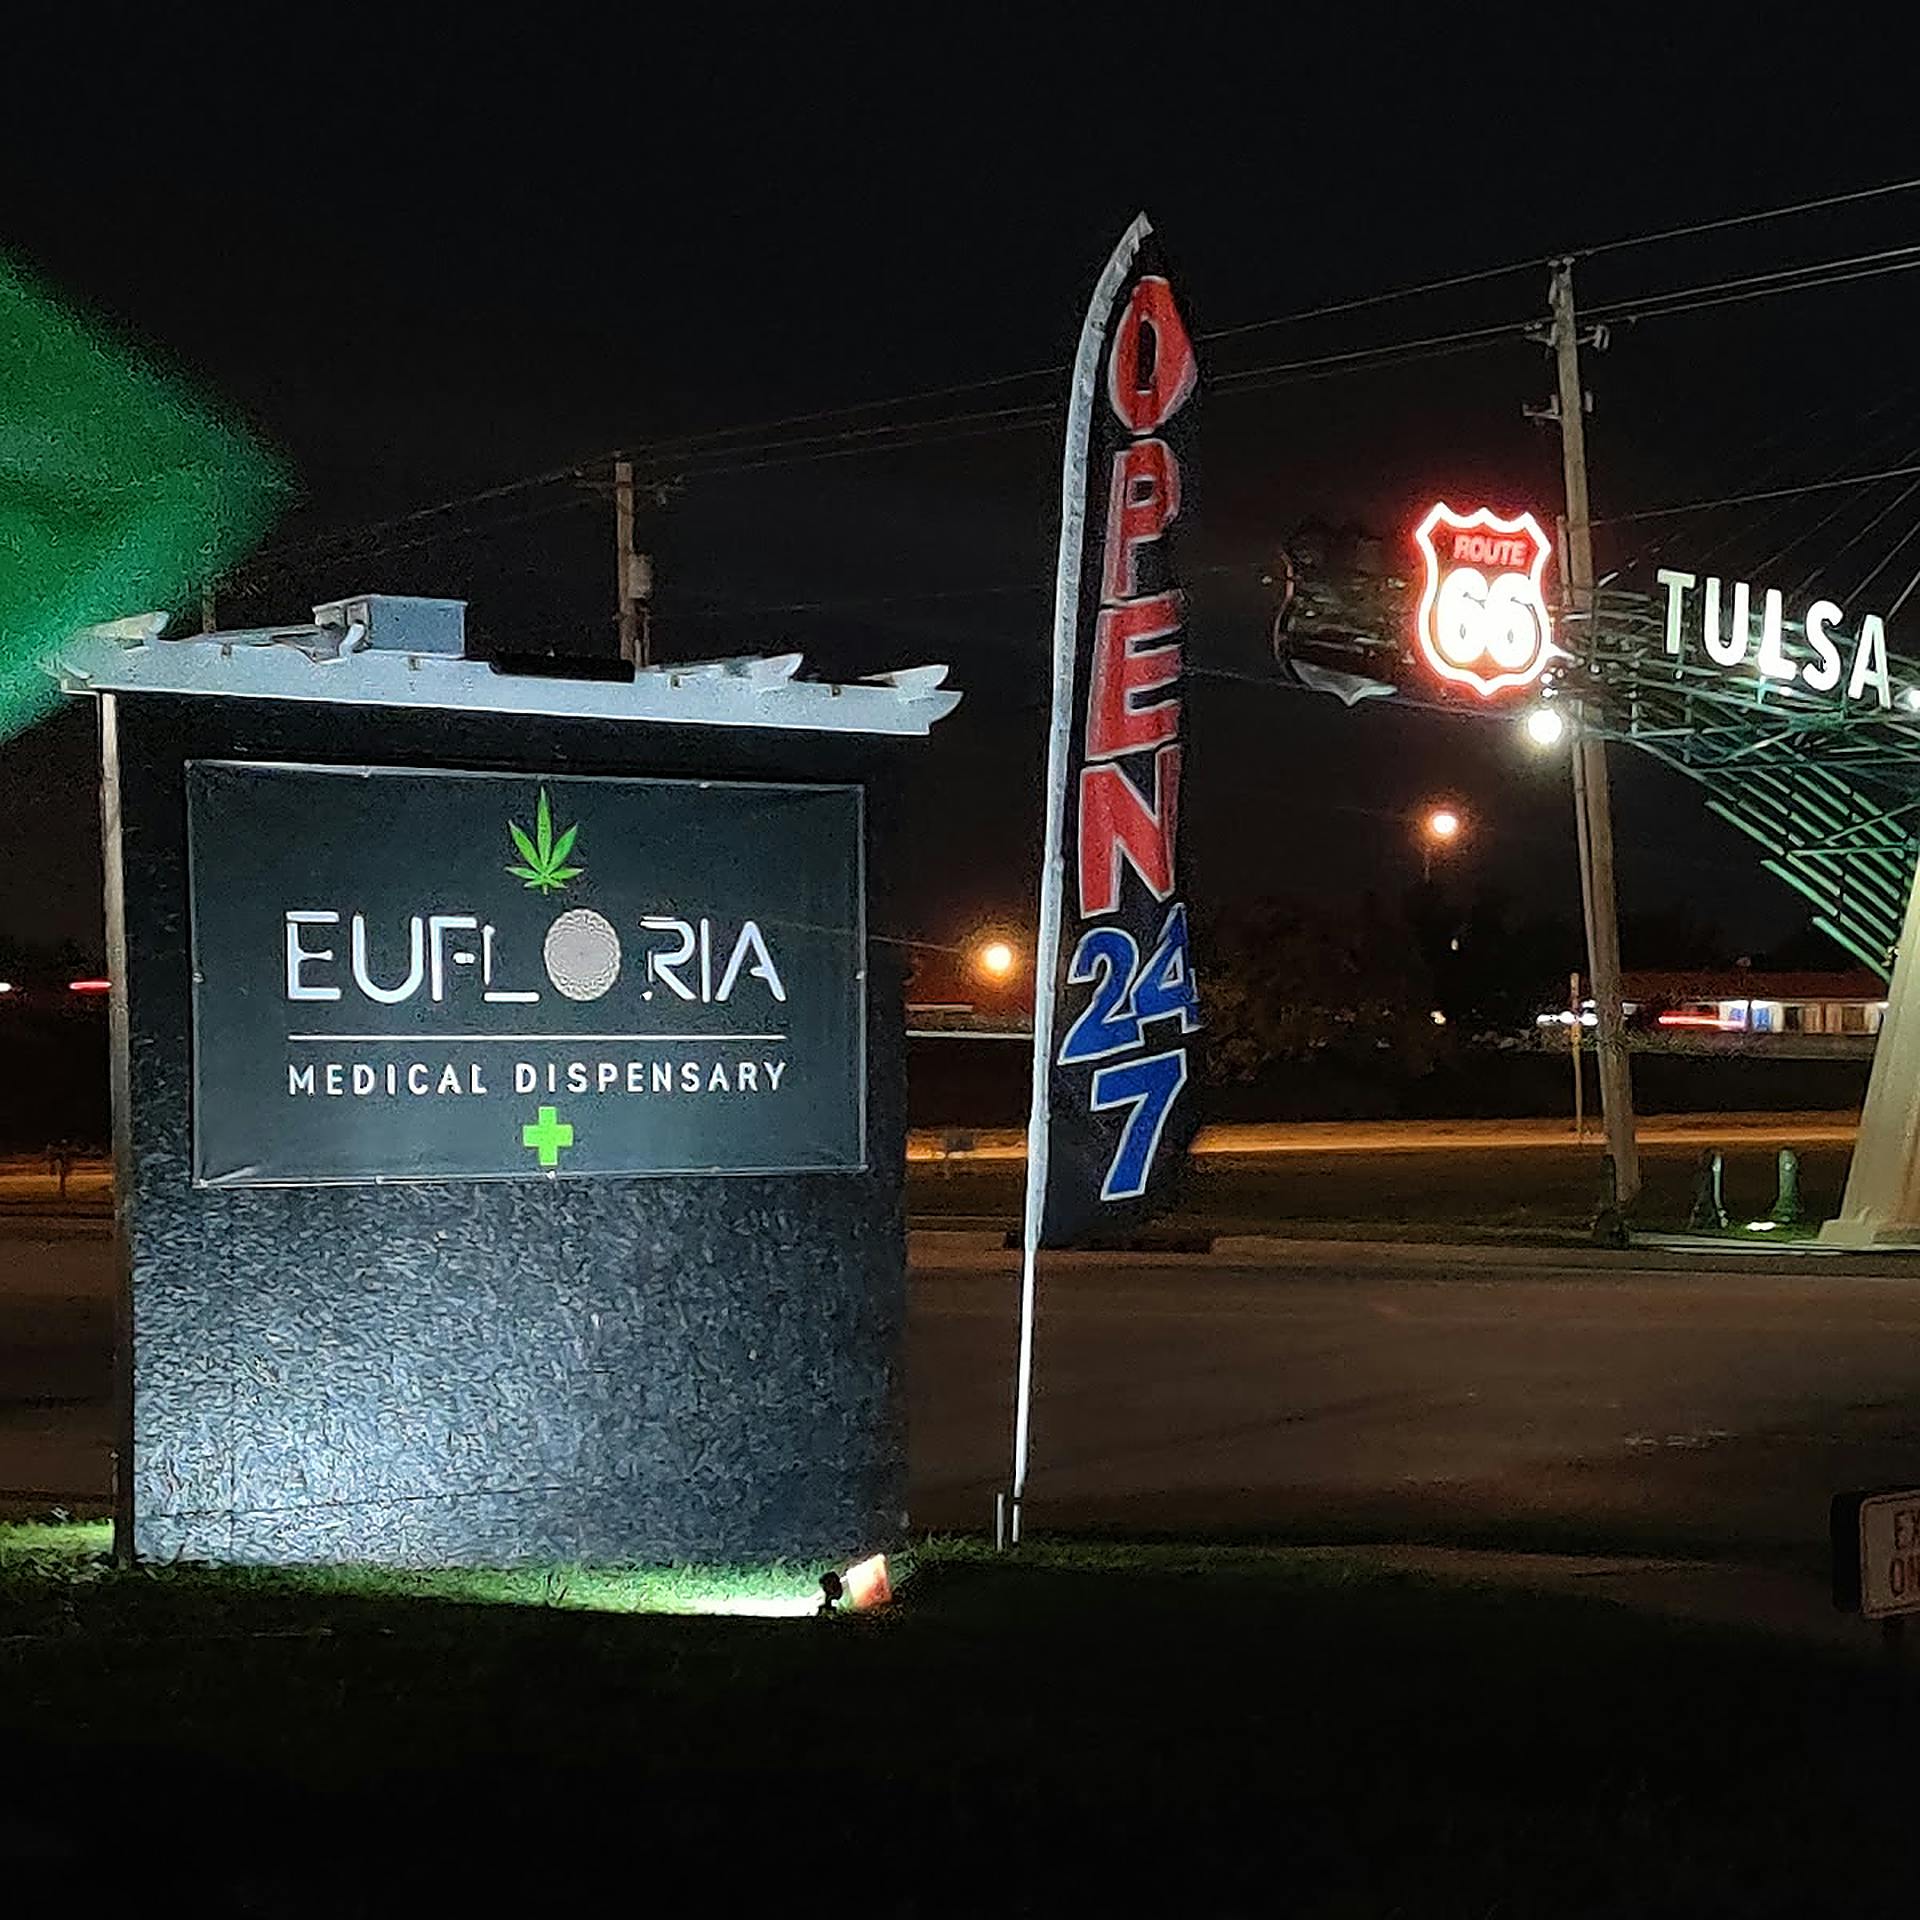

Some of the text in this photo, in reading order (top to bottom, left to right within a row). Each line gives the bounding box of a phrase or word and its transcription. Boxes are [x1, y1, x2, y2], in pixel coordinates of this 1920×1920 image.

[1079, 274, 1199, 920] OPEN
[1453, 534, 1528, 566] ROUTE
[1437, 567, 1538, 668] 66
[1658, 568, 1891, 709] TULSA
[286, 908, 786, 1004] EUFLORIA
[1057, 902, 1204, 1066] 24
[288, 1060, 787, 1096] MEDICAL DISPENSARY
[1090, 1048, 1188, 1201] 7
